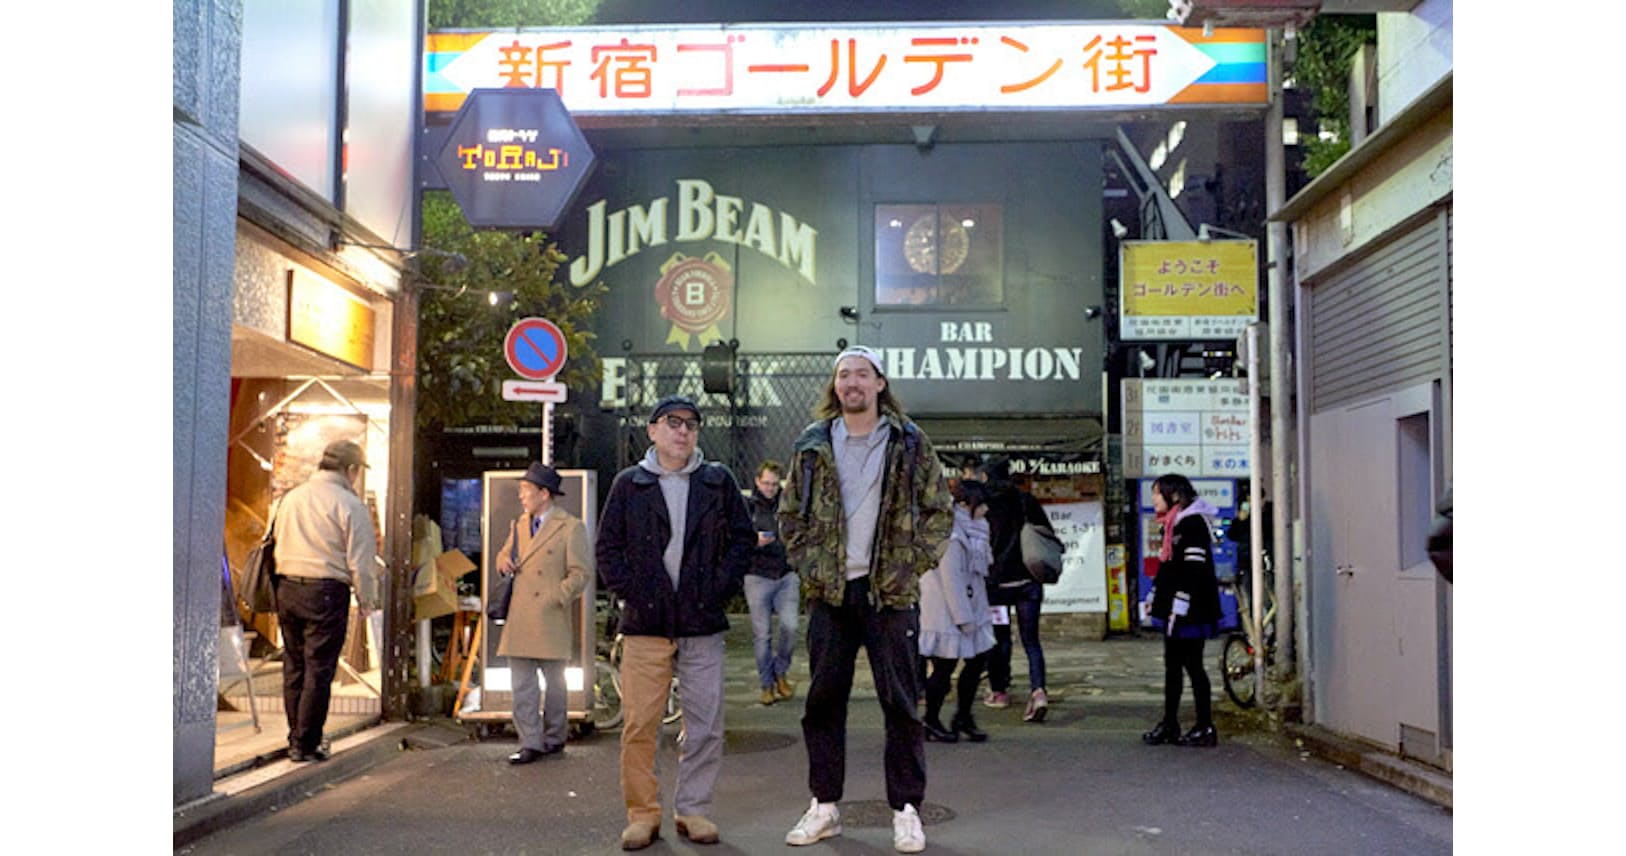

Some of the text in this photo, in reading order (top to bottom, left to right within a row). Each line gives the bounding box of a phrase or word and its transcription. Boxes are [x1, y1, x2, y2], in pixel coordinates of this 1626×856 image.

[498, 34, 1158, 98] 新宿ゴールデン街
[569, 179, 818, 287] JIM BEAM
[1158, 259, 1220, 274] ようこそ
[686, 283, 704, 305] B
[1133, 283, 1246, 297] ゴールデン街へ
[940, 322, 993, 342] BAR
[600, 357, 782, 408] BLAK
